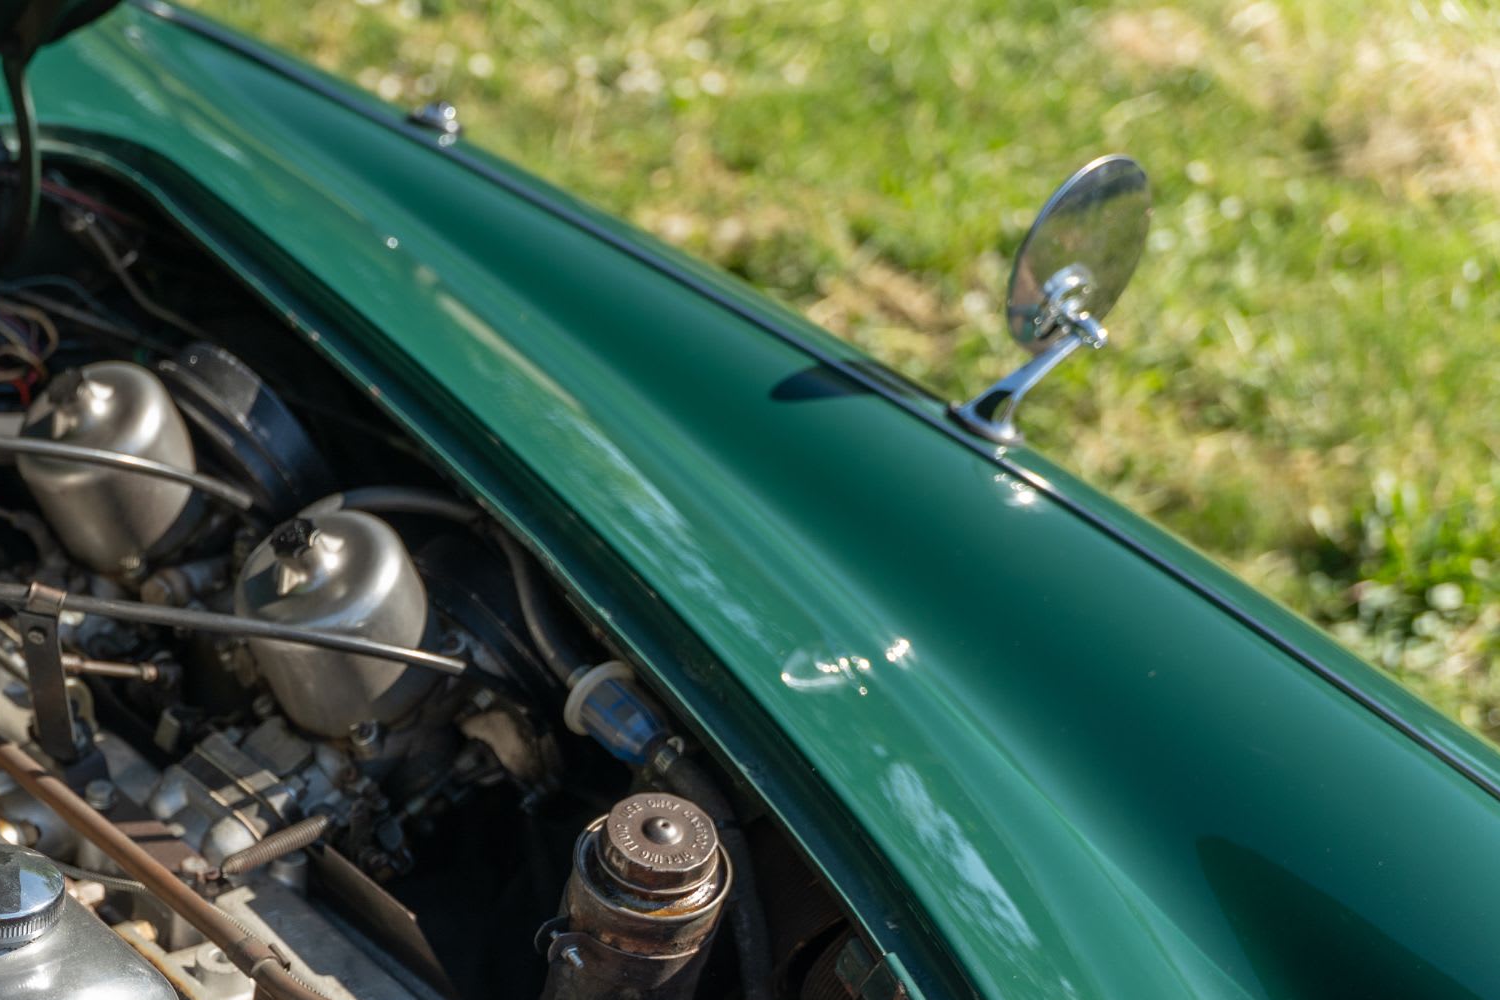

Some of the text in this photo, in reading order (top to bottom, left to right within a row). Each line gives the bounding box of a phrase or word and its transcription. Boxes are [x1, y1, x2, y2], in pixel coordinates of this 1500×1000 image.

[620, 801, 643, 819] USE
[647, 799, 680, 811] ONLY
[642, 850, 695, 865] GIRLING
